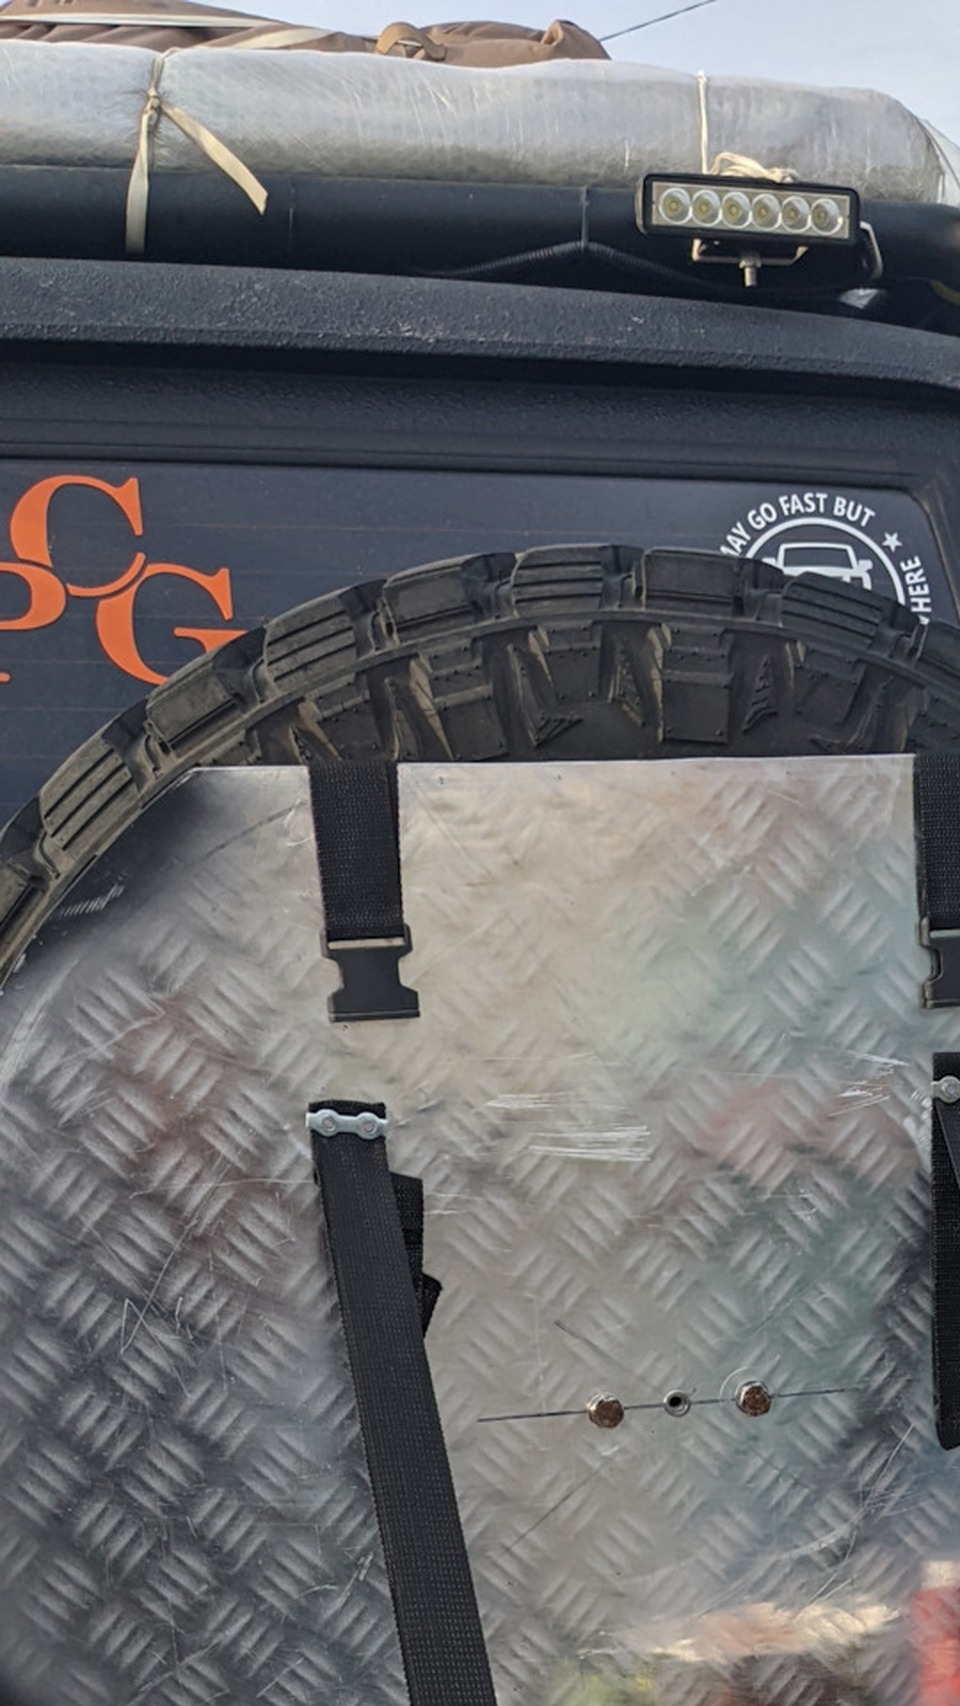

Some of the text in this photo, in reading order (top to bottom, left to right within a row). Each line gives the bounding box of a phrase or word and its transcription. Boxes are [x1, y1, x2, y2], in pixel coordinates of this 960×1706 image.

[747, 502, 778, 531] GO
[778, 491, 829, 517] FAST
[833, 495, 876, 527] BUT
